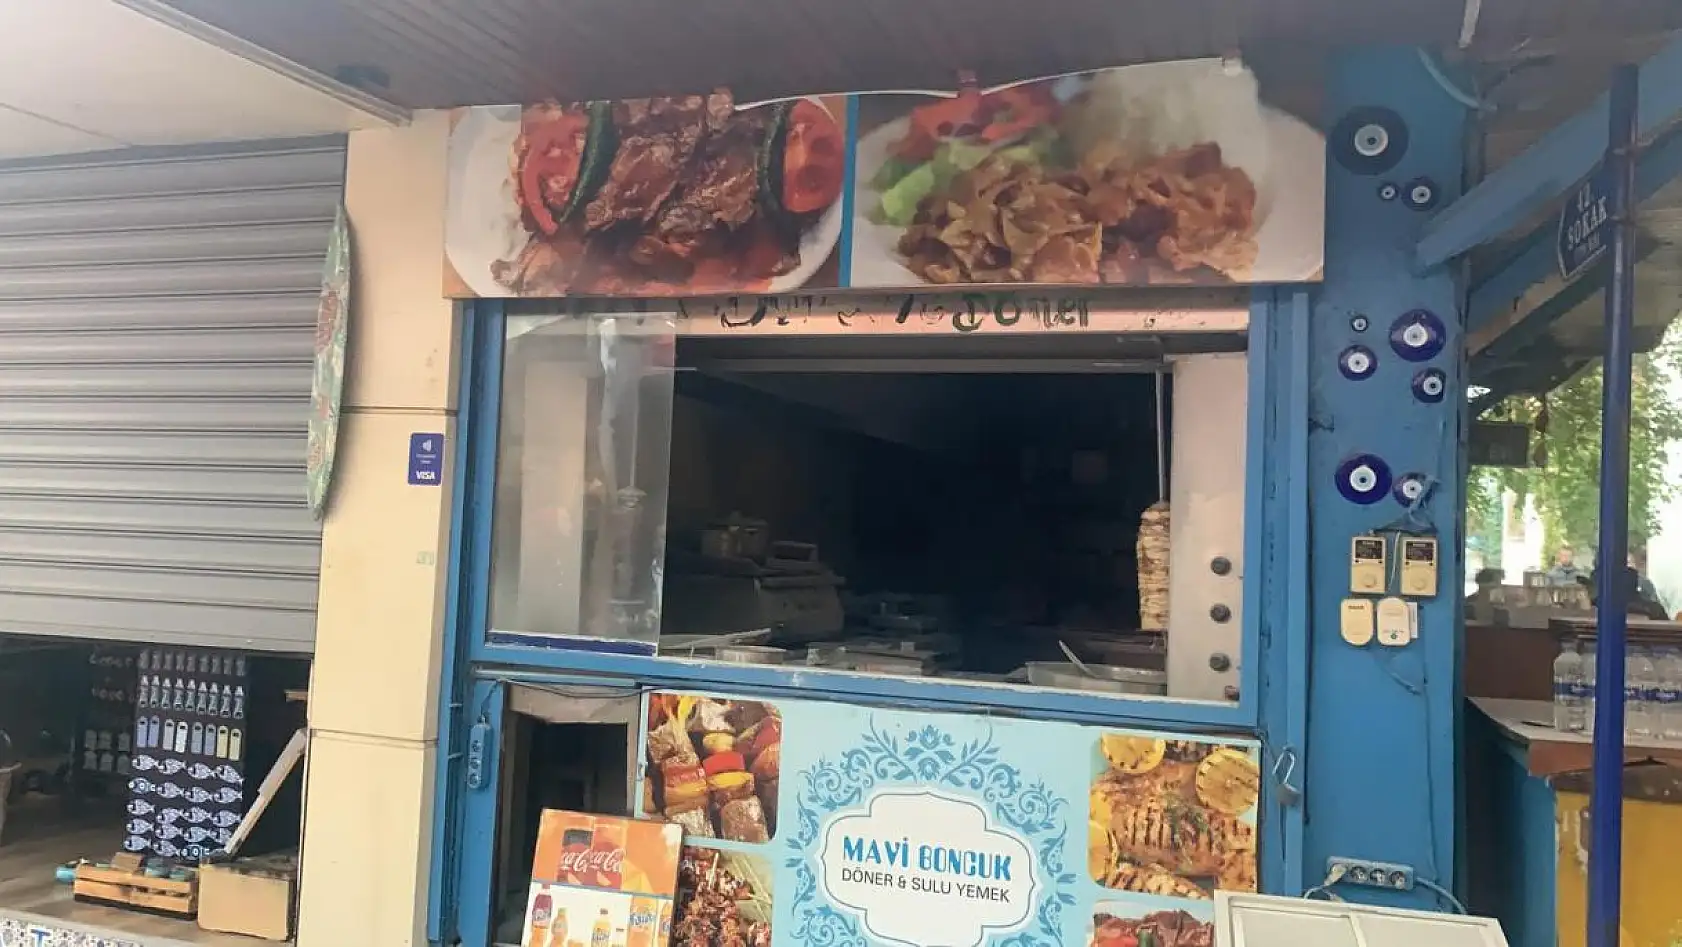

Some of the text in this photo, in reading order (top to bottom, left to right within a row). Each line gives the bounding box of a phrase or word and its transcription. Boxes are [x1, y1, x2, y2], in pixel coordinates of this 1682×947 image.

[1567, 196, 1607, 251] SOKAK
[416, 470, 436, 480] VISA
[919, 844, 1012, 882] BONCUK
[842, 866, 1011, 903] DÖNER & SULU YEMEK
